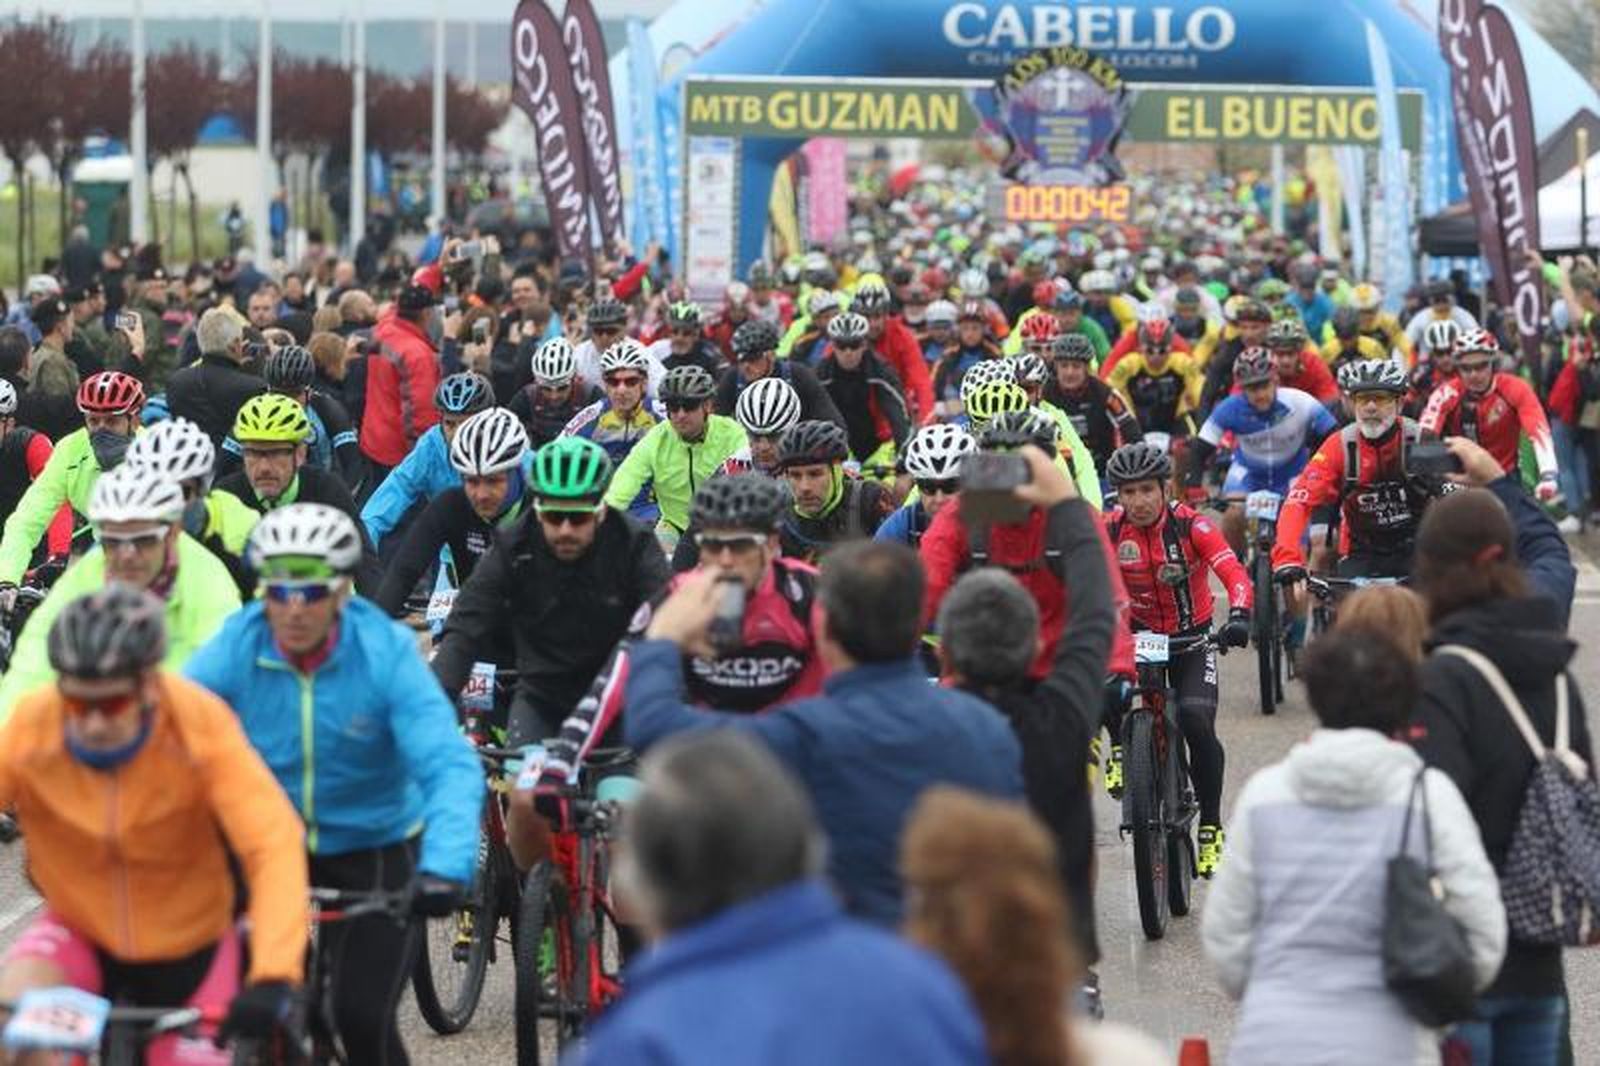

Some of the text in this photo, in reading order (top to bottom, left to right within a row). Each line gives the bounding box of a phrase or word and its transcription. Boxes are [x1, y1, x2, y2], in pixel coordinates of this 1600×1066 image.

[942, 3, 1236, 50] CABELLO
[690, 90, 959, 132] MTB GUZMAN
[1166, 95, 1383, 140] EL BUENO
